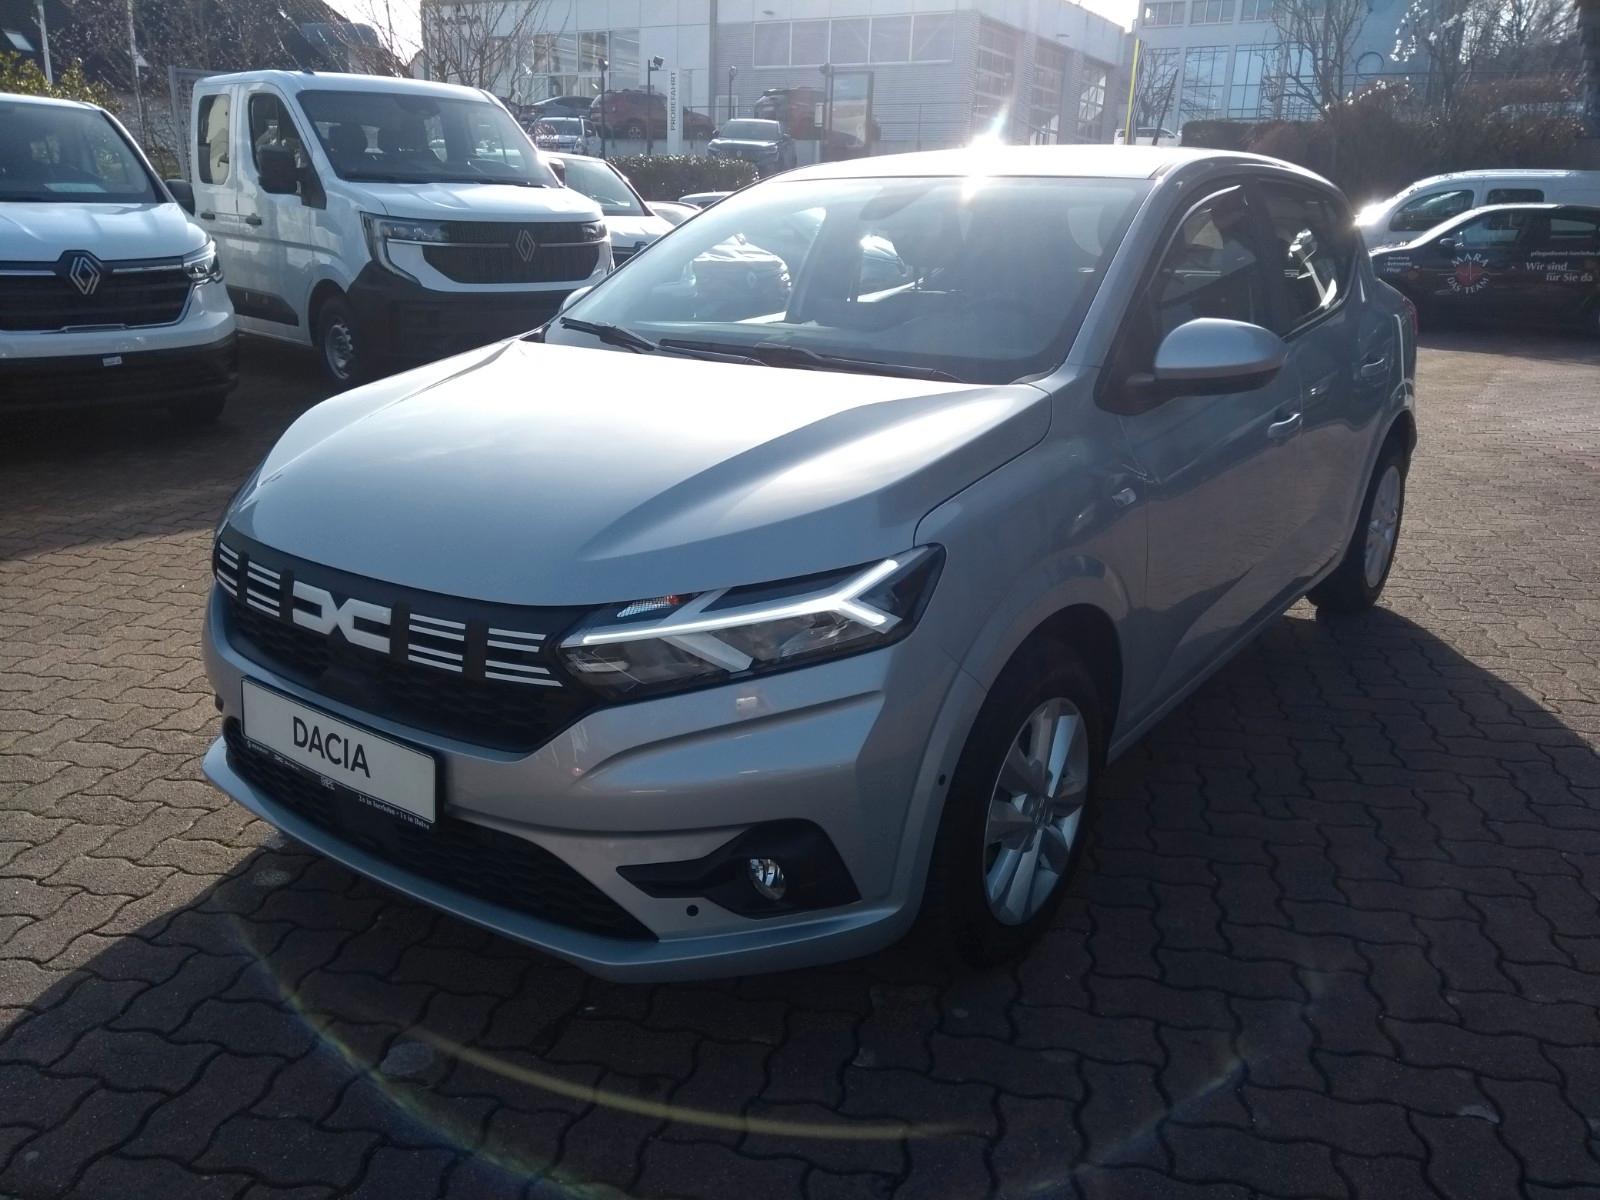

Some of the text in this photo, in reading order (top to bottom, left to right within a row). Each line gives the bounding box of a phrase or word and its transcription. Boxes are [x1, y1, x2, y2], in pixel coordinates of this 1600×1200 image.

[1451, 252, 1489, 270] MARA
[1525, 261, 1568, 271] Wir sind
[1545, 271, 1593, 281] für Sie da
[1447, 277, 1489, 295] DAS TEAM
[293, 716, 370, 778] DACIA
